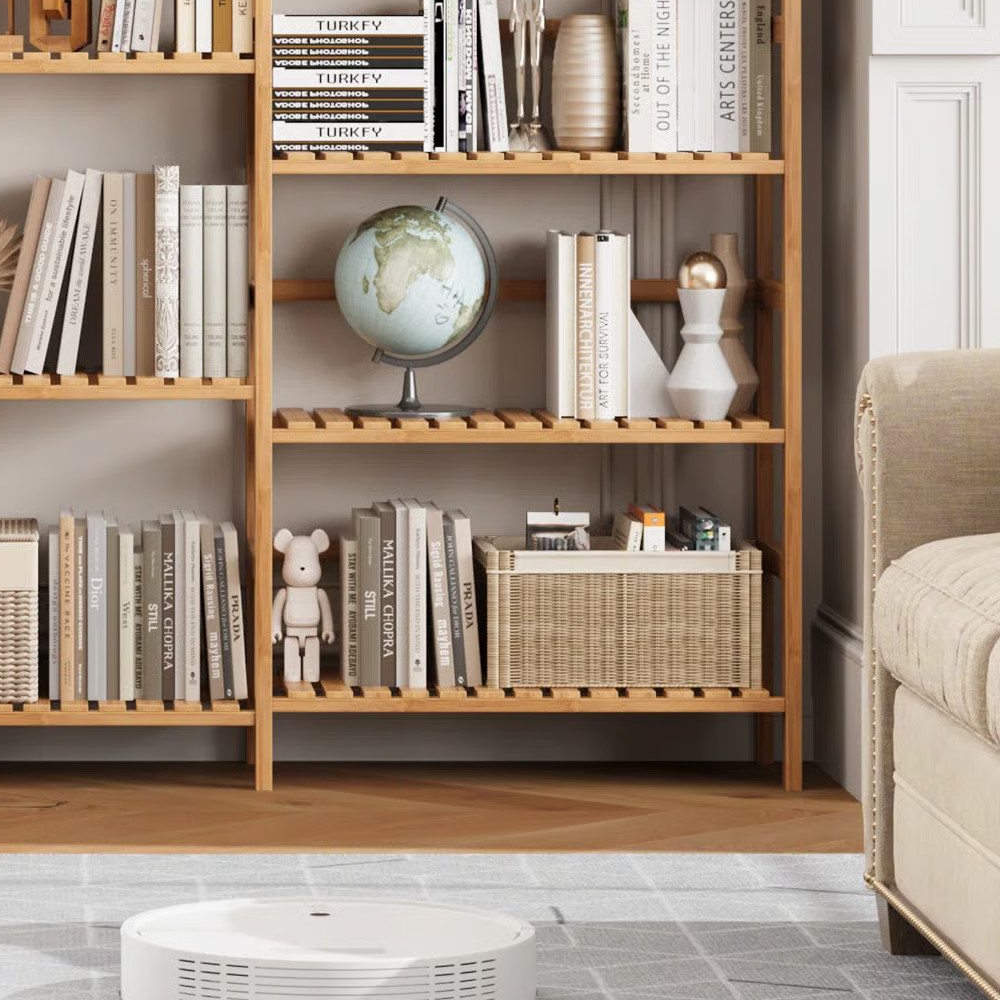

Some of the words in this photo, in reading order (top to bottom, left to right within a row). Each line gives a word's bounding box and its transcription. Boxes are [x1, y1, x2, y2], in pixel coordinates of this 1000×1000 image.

[719, 0, 736, 74] CENTERS
[756, 5, 766, 45] England
[632, 29, 640, 115] Secondhomes!
[641, 52, 650, 81] Home
[657, 43, 670, 70] THE
[643, 85, 650, 93] at
[657, 79, 670, 95] OF
[719, 80, 735, 122] ARTS
[657, 103, 670, 131] OUT
[755, 100, 764, 137] Kingdom
[110, 199, 118, 215] ON
[46, 290, 54, 302] for
[50, 231, 67, 280] sustainable
[61, 194, 75, 229] lifestyle
[110, 221, 118, 287] IMMUNITY
[25, 302, 35, 324] THIS
[34, 252, 46, 282] GOOD
[40, 221, 53, 252] GUIDE
[69, 288, 81, 325] DREAM
[78, 222, 91, 258] AWAKE
[140, 259, 152, 298] spherical
[578, 262, 593, 411] INNENARCHITEKTUR
[599, 362, 609, 384] FOR
[598, 388, 609, 409] ART
[348, 553, 356, 570] STAY
[431, 541, 441, 568] Sigrid
[447, 535, 455, 559] JOHN
[164, 552, 173, 612] MALLIKA
[203, 553, 214, 582] Sigrid
[383, 539, 394, 598] MALLIKA
[449, 559, 458, 605] GALLIANO
[91, 578, 103, 611] Dior
[206, 584, 216, 620] Rausing
[349, 593, 357, 605] ME
[364, 591, 376, 620] STILL
[434, 571, 445, 607] Rausing
[463, 582, 474, 629] PRADA
[135, 606, 142, 618] ME
[148, 603, 158, 633] STILL
[231, 594, 240, 642] PRADA
[164, 617, 173, 671] CHOPRA
[383, 604, 394, 658] CHOPRA
[437, 619, 451, 666] mayhem
[208, 631, 221, 679] mayhem
